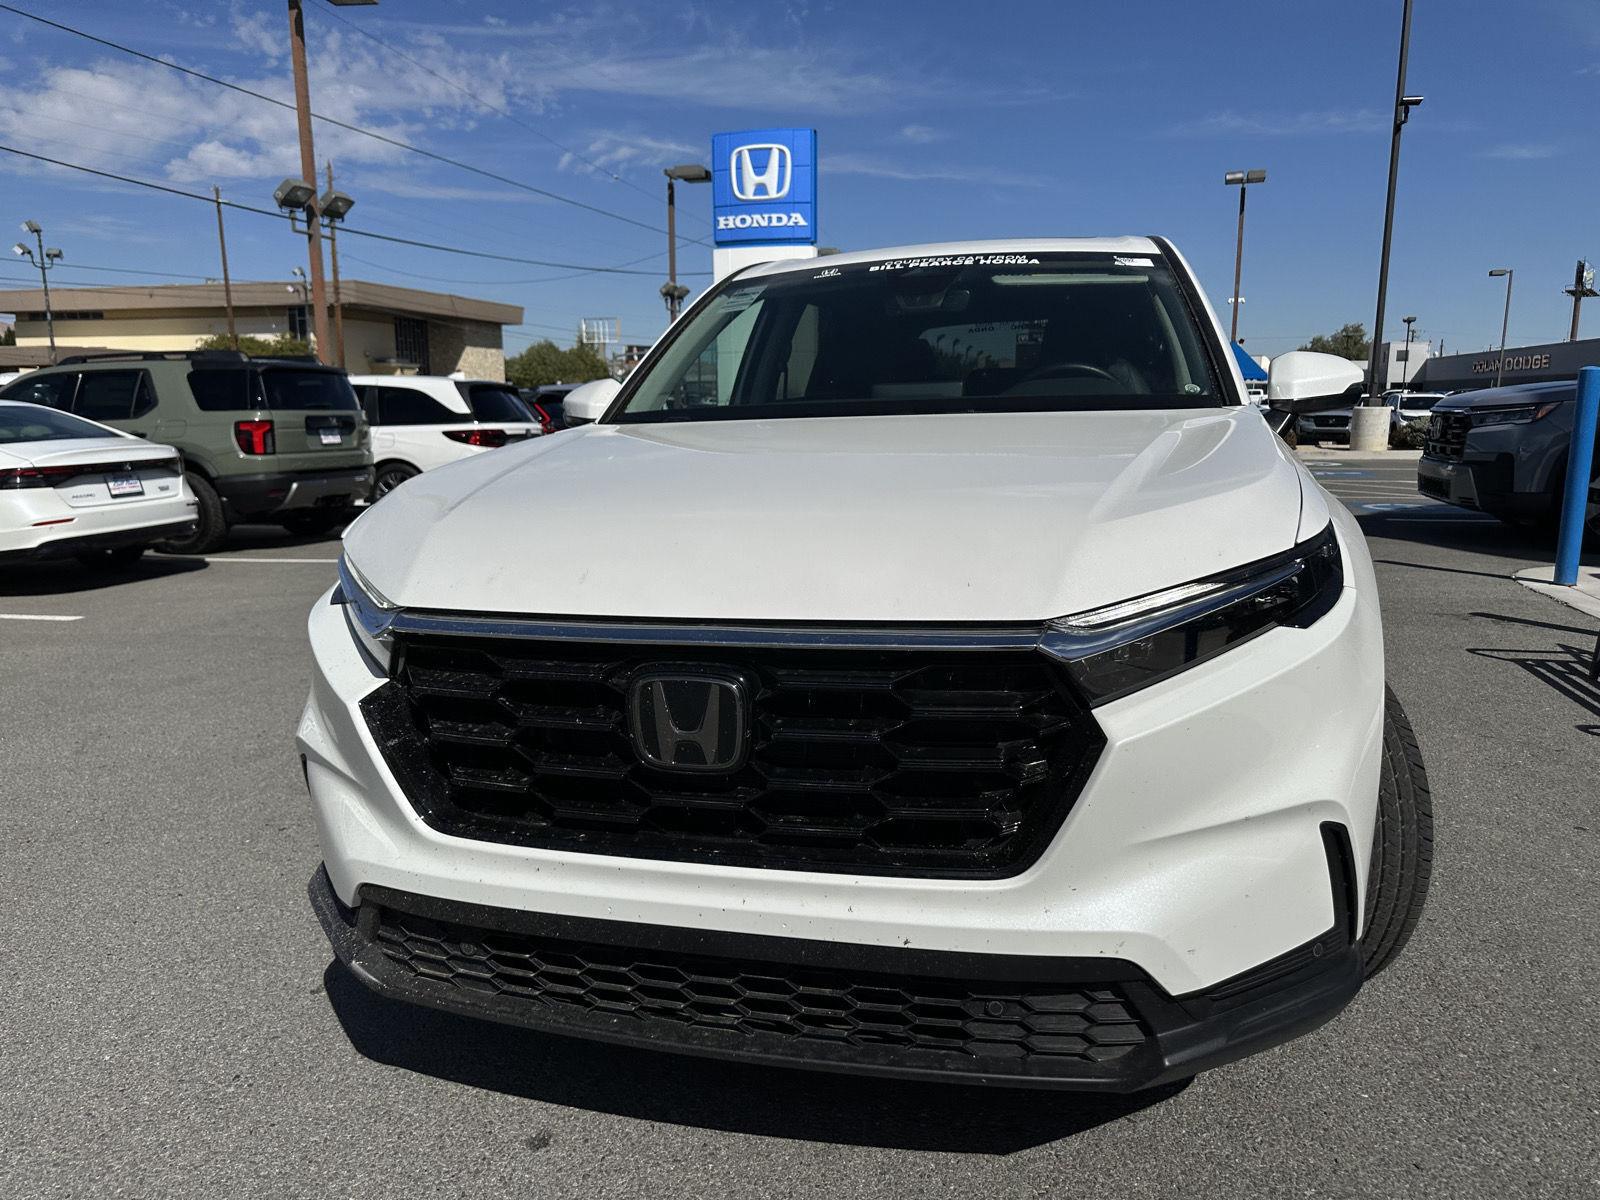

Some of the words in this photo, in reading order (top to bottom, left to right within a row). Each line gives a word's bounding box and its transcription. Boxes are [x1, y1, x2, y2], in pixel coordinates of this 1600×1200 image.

[717, 212, 808, 229] HONDA
[869, 264, 904, 272] BILL
[909, 259, 974, 267] PEARCE
[1505, 354, 1550, 370] DODGE
